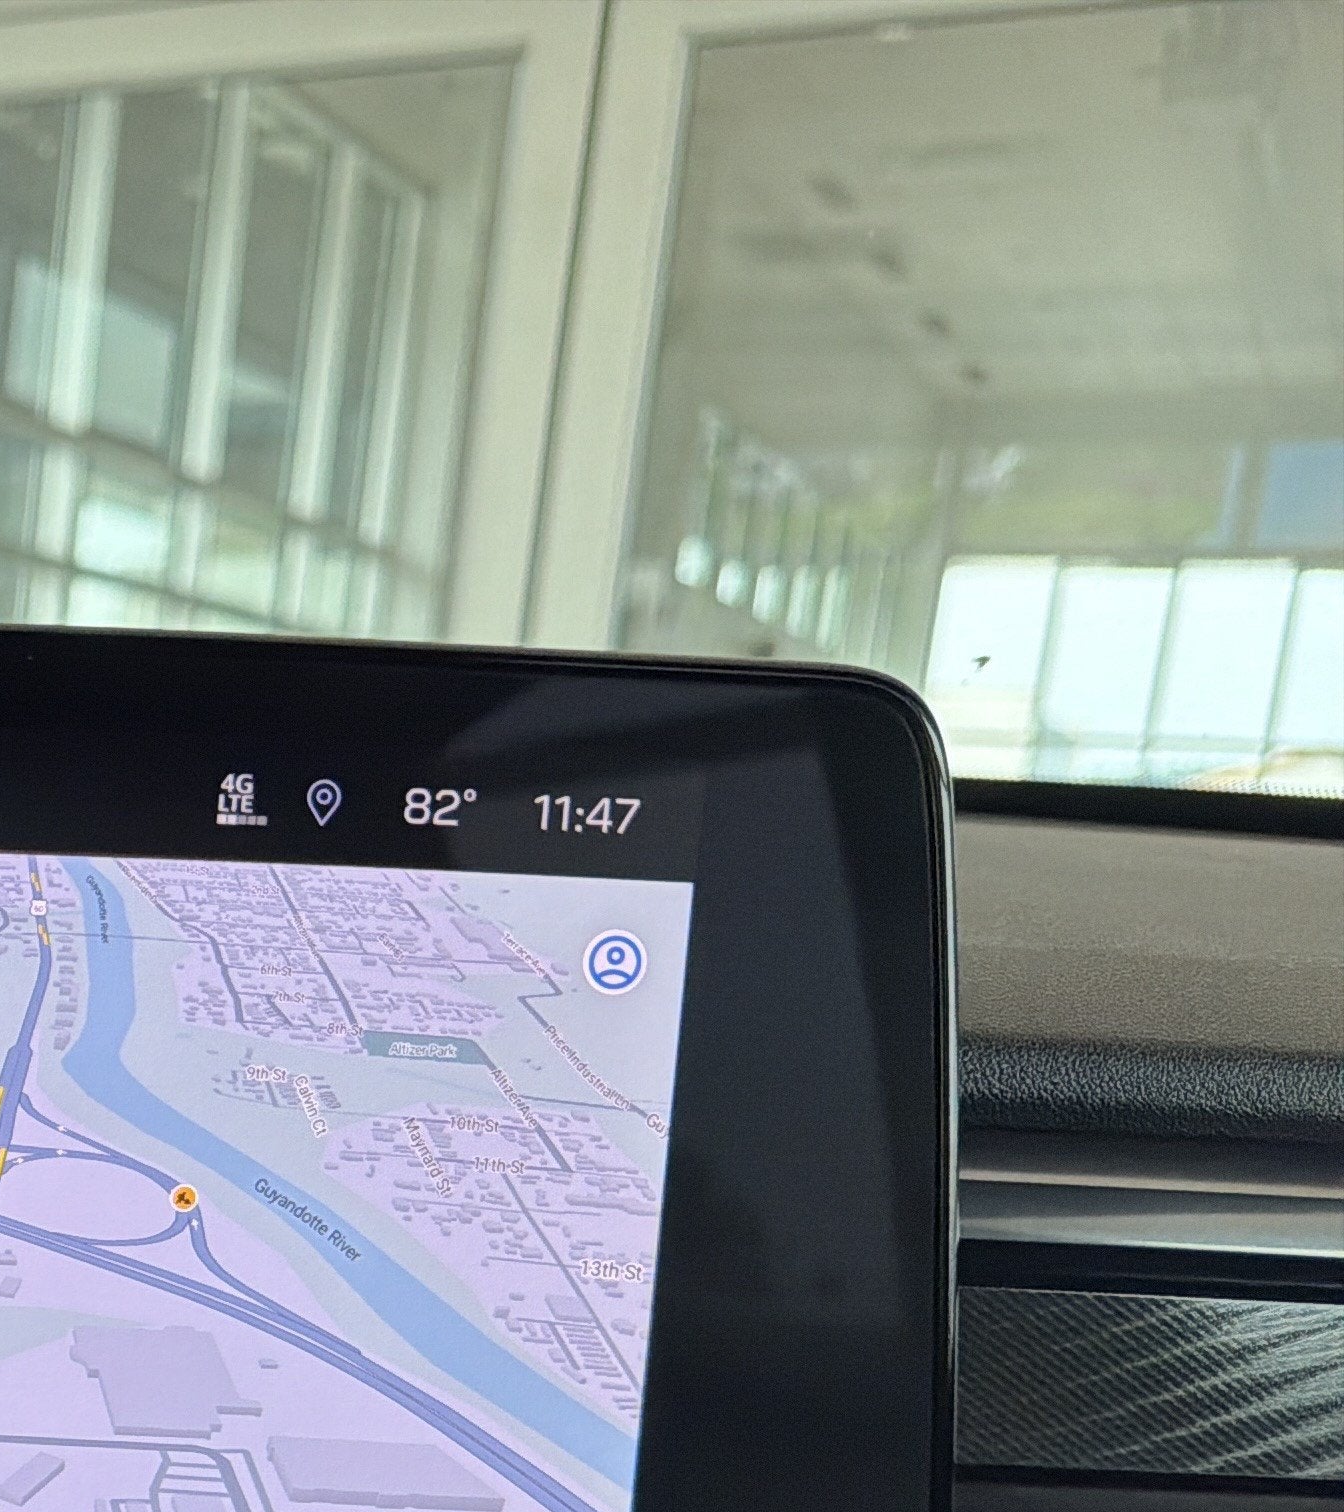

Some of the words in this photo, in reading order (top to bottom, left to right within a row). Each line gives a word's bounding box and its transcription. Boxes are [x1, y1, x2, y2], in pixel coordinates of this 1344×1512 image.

[220, 773, 255, 794] 4G
[218, 793, 255, 814] LTE
[403, 787, 478, 827] 82°
[533, 793, 642, 835] 11:47
[326, 1022, 347, 1035] 8th
[348, 1023, 364, 1037] St
[429, 1045, 455, 1057] Park
[246, 1066, 269, 1080] 9th
[271, 1067, 287, 1081] St
[294, 1076, 319, 1120] Calvin
[311, 1117, 328, 1136] Ct
[450, 1116, 480, 1131] 10th
[484, 1118, 499, 1132] St
[404, 1117, 444, 1179] Maynard
[435, 1177, 453, 1197] St
[473, 1156, 506, 1173] 11th
[511, 1159, 525, 1174] St
[253, 1177, 329, 1236] Guyandotte
[328, 1229, 362, 1262] River
[580, 1259, 619, 1279] 13th
[624, 1264, 643, 1281] St
